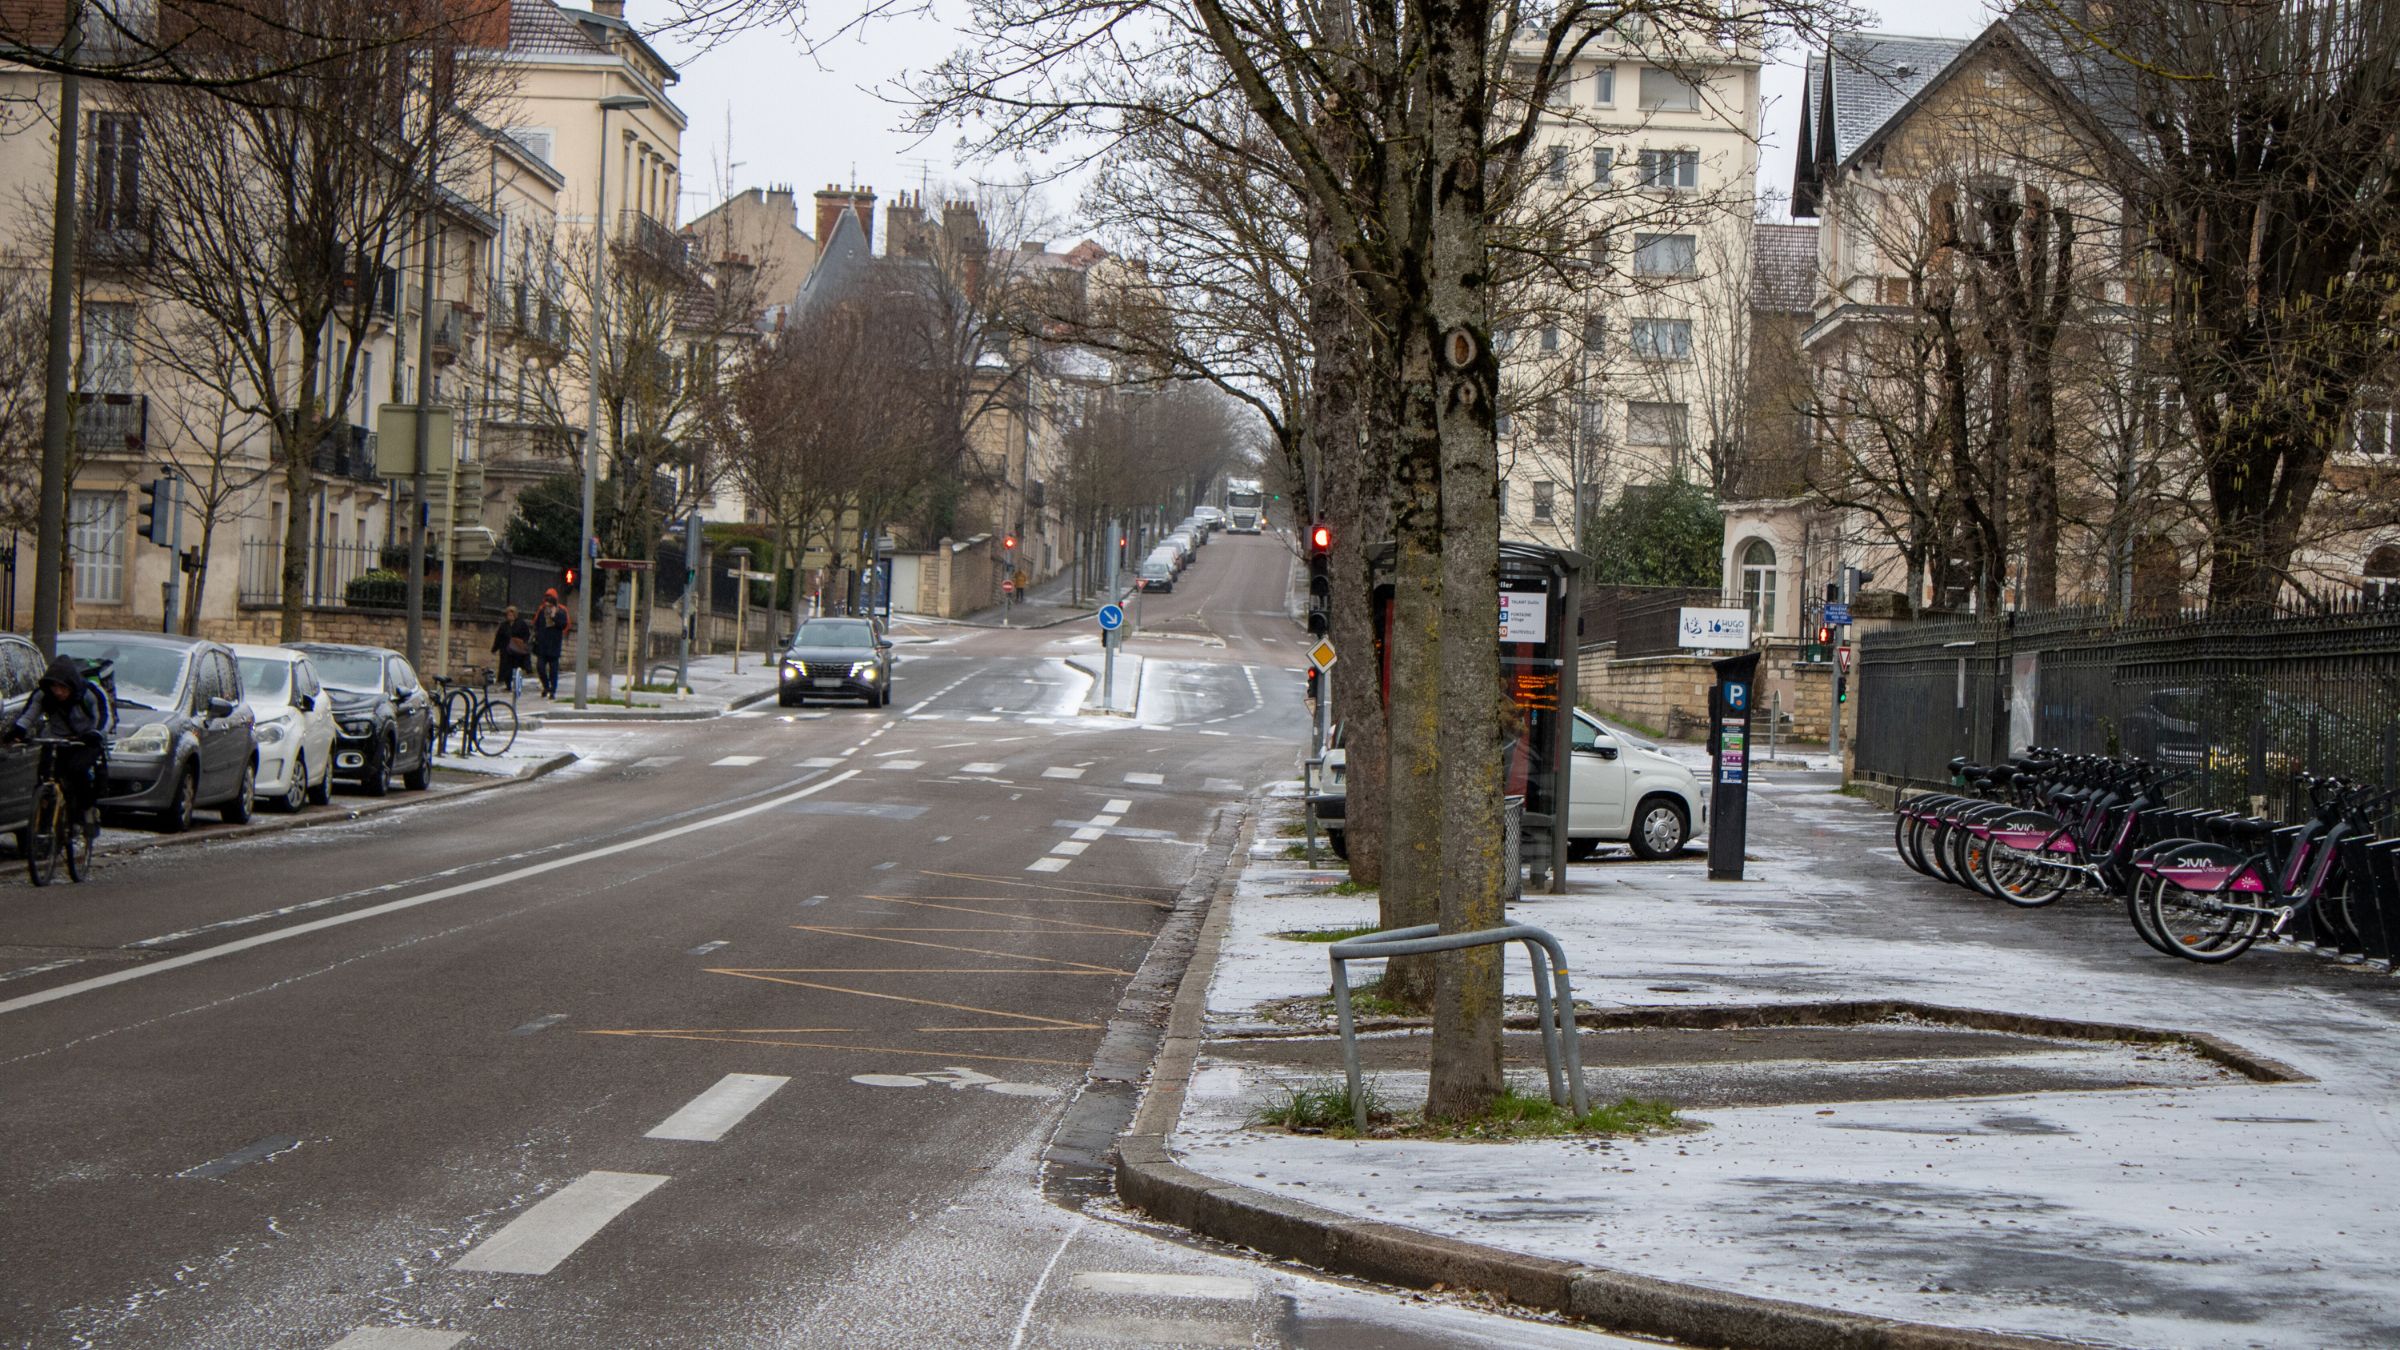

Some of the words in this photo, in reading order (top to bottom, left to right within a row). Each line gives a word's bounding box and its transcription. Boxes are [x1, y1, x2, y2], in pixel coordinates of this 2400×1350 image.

[1708, 619, 1721, 632] 16
[1722, 620, 1744, 628] HUGO
[1730, 685, 1743, 705] P
